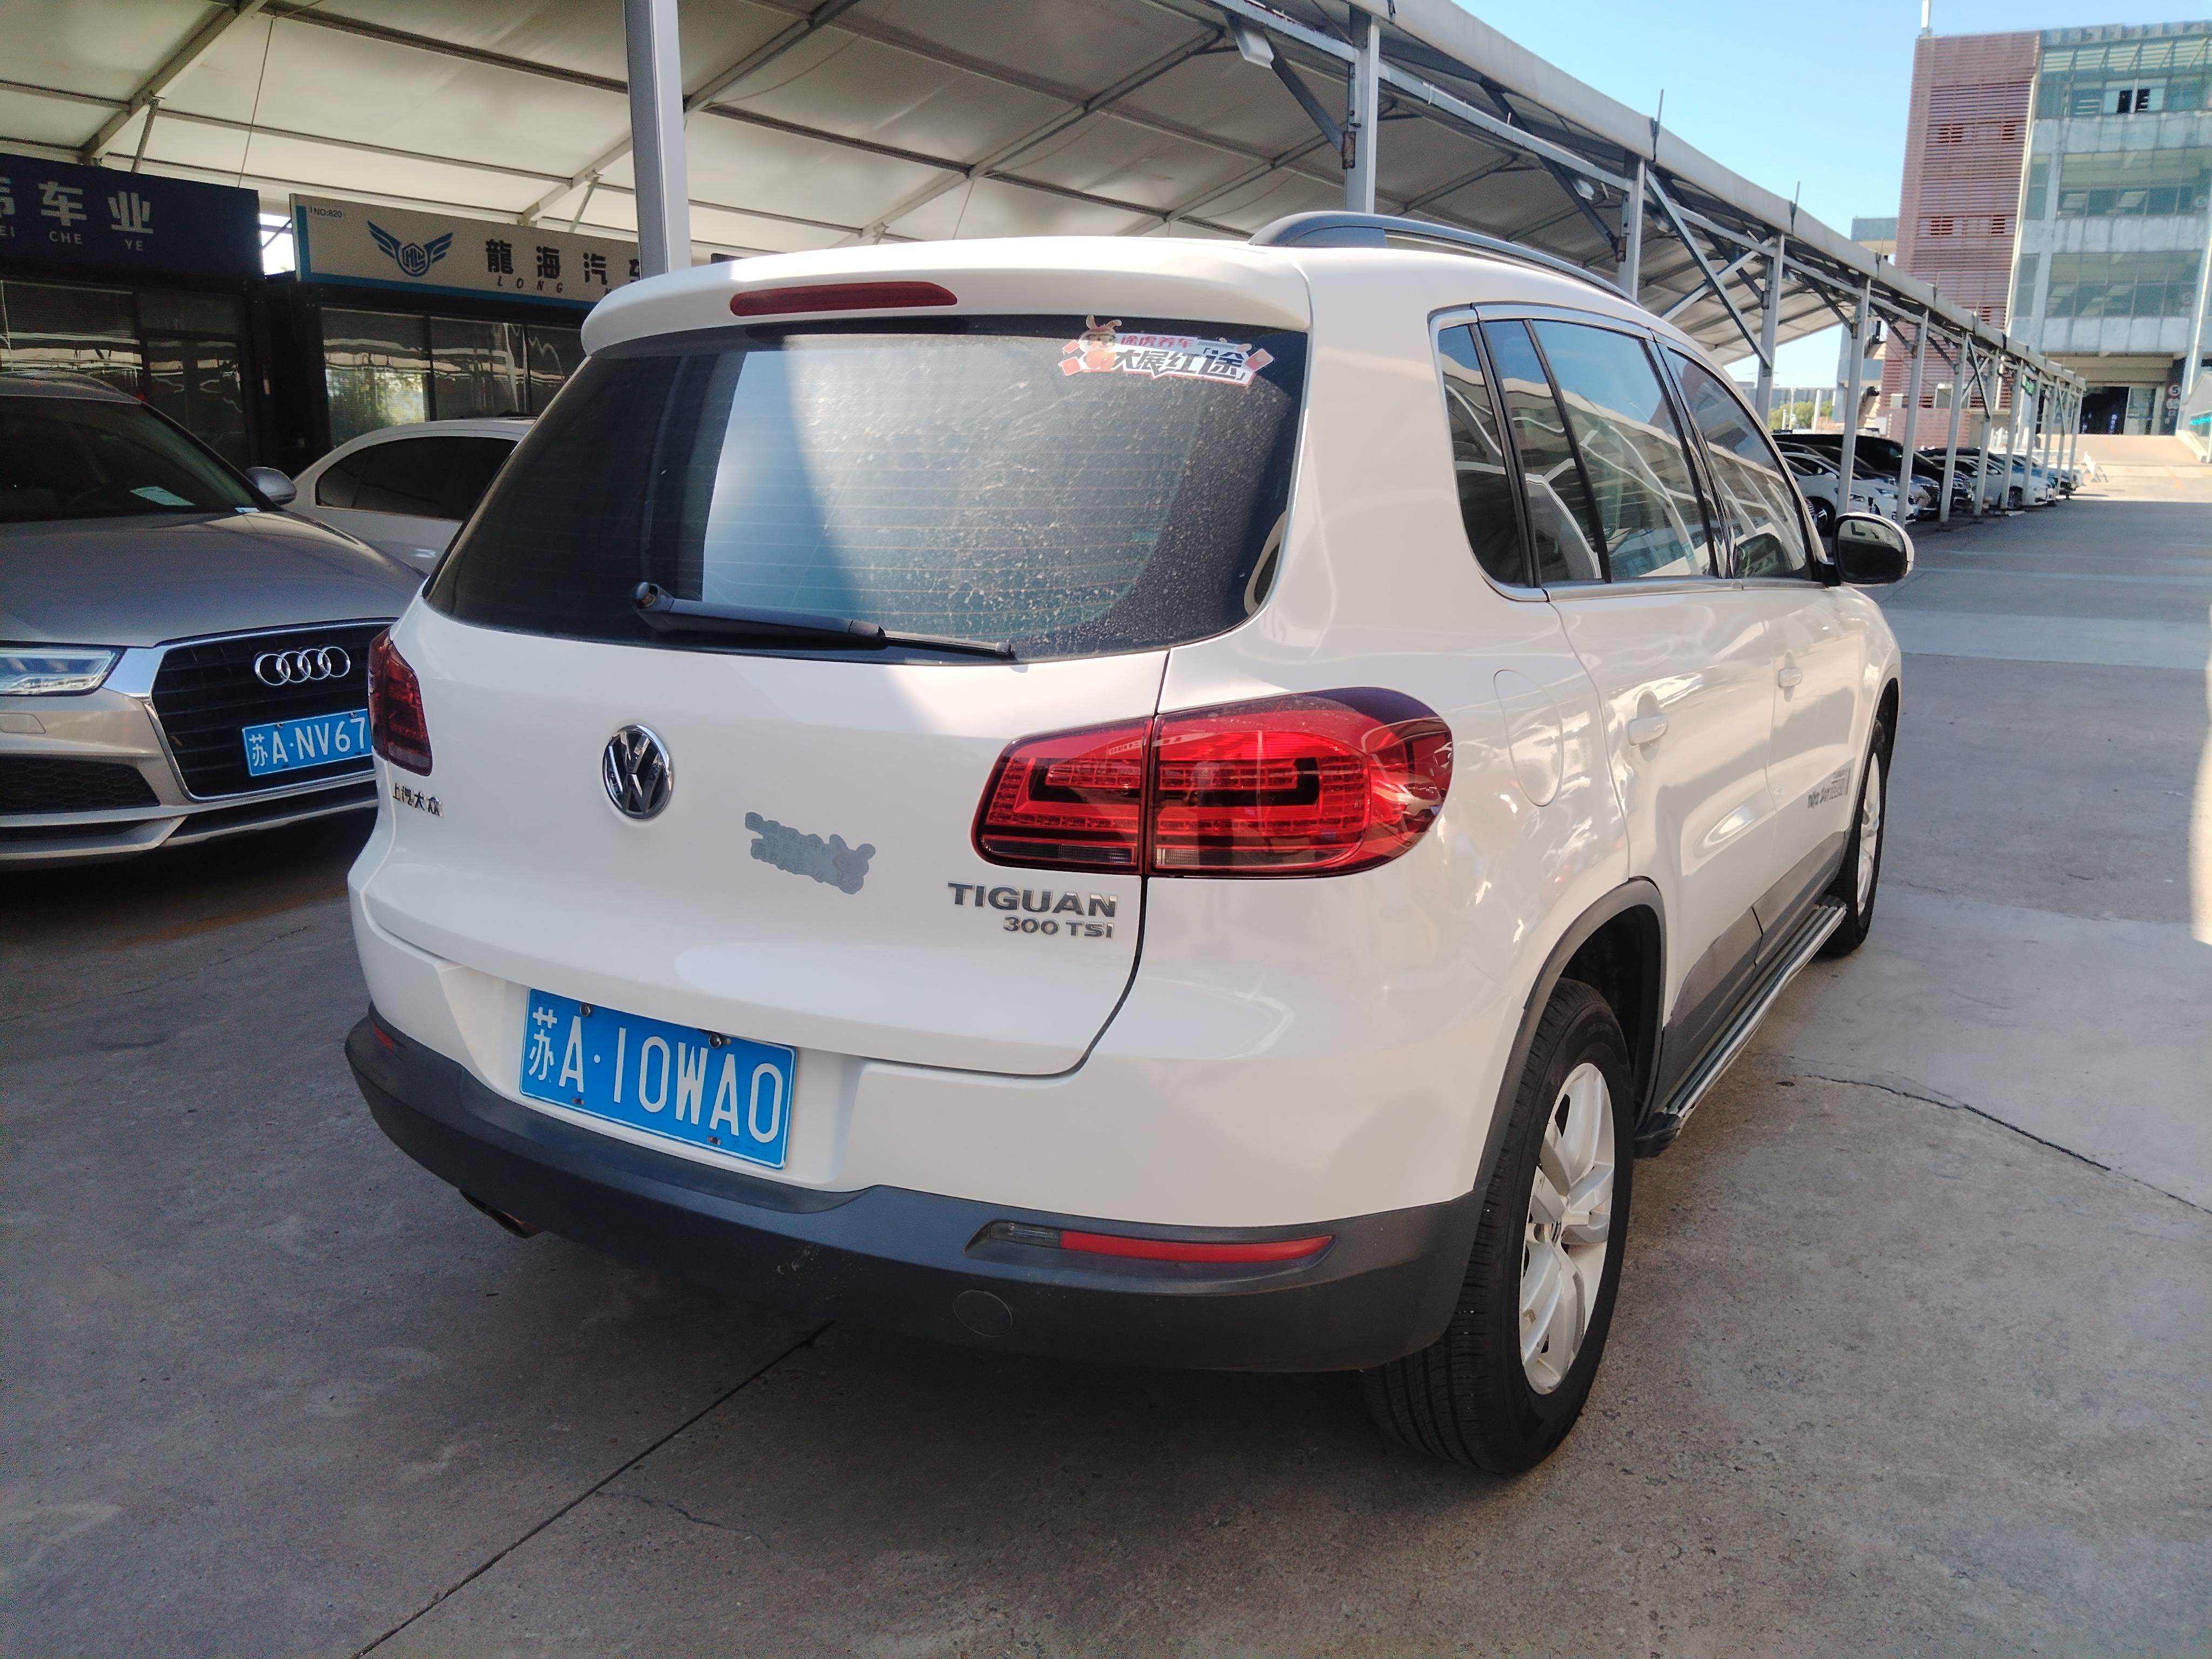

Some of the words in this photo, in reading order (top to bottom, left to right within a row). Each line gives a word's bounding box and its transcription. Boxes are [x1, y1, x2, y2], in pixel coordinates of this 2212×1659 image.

[49, 231, 83, 244] CHE
[125, 239, 144, 251] YE
[497, 275, 563, 293] LONG
[1121, 335, 1195, 349] 途虎养车
[249, 717, 366, 767] 苏A·NV67
[948, 881, 1117, 918] TIGUAN
[1003, 915, 1060, 935] 300
